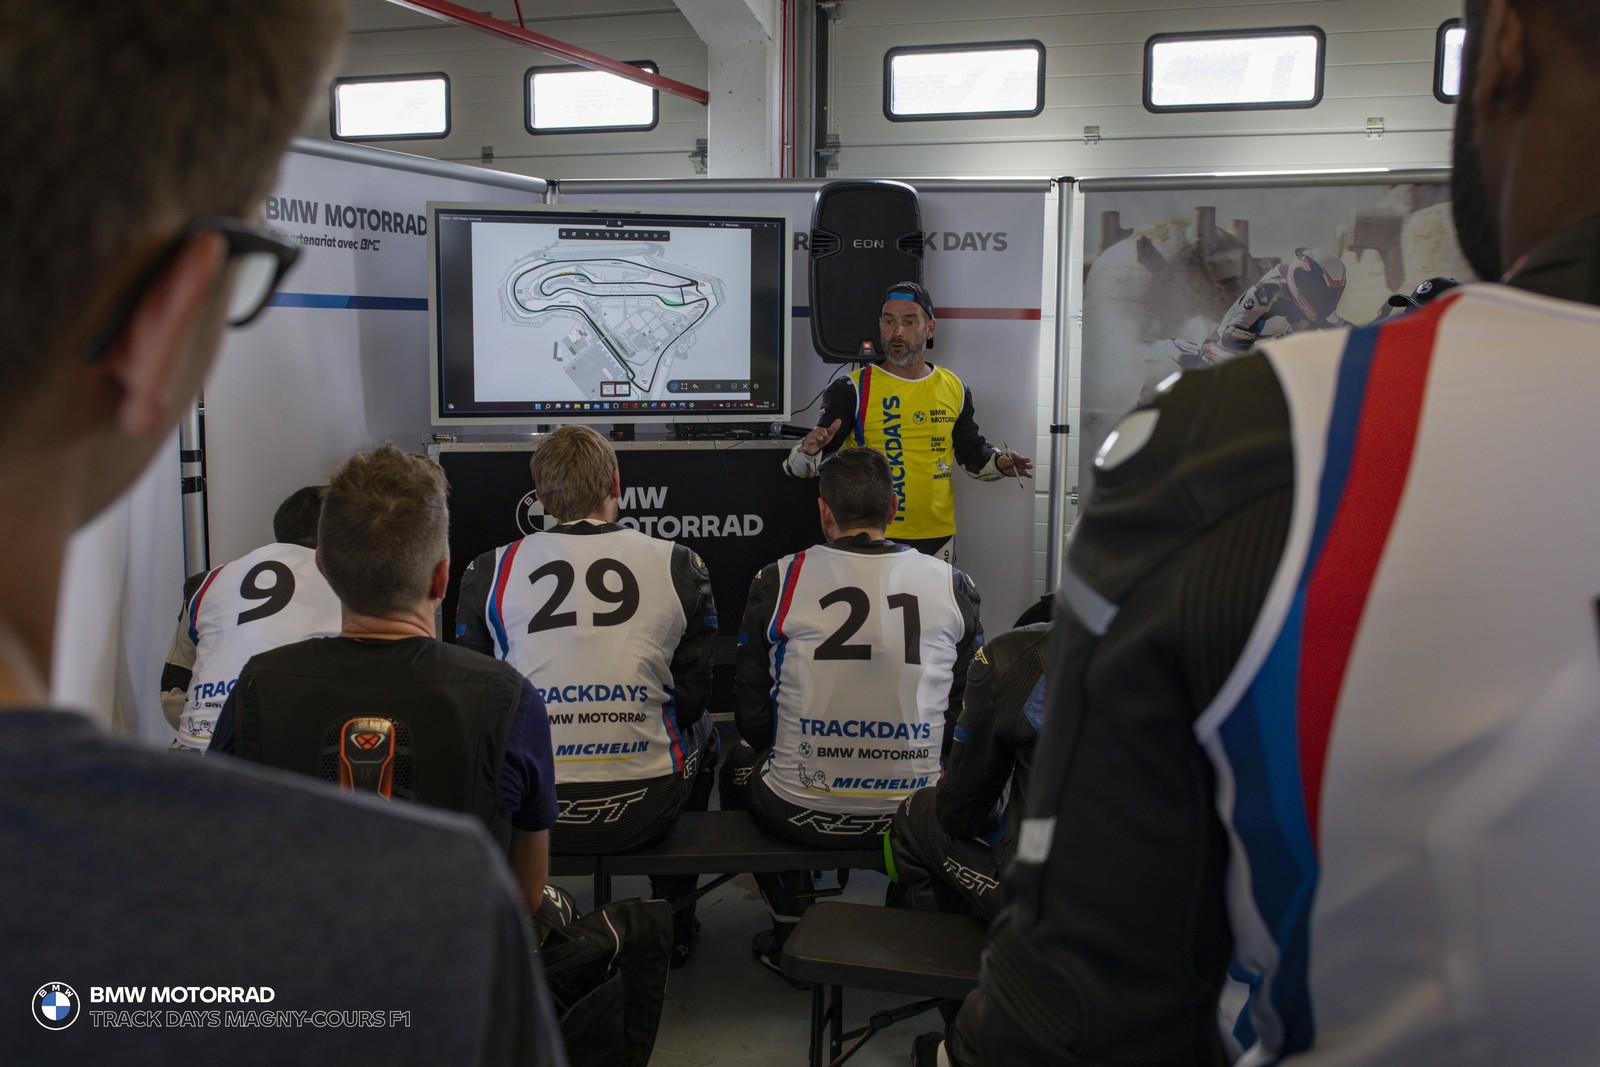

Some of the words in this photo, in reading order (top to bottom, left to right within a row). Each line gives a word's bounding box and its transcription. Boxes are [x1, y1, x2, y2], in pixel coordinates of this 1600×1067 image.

[265, 196, 318, 224] BMW
[325, 203, 427, 236] MOTORRAD
[337, 238, 359, 250] avec
[853, 239, 884, 249] EON
[943, 231, 1008, 252] DAYS
[617, 486, 668, 510] MW
[237, 560, 295, 626] 9
[527, 557, 640, 634] 29
[813, 586, 922, 666] 21
[549, 713, 574, 725] MW
[578, 712, 646, 724] MOTORRAD
[799, 718, 930, 740] TRACKDAYS
[555, 741, 650, 756] MICHELIN
[817, 747, 854, 758] BMW
[858, 748, 929, 761] MOTORRAD
[832, 776, 928, 790] MICHELIN
[556, 787, 648, 824] ST
[943, 856, 1000, 896] RST
